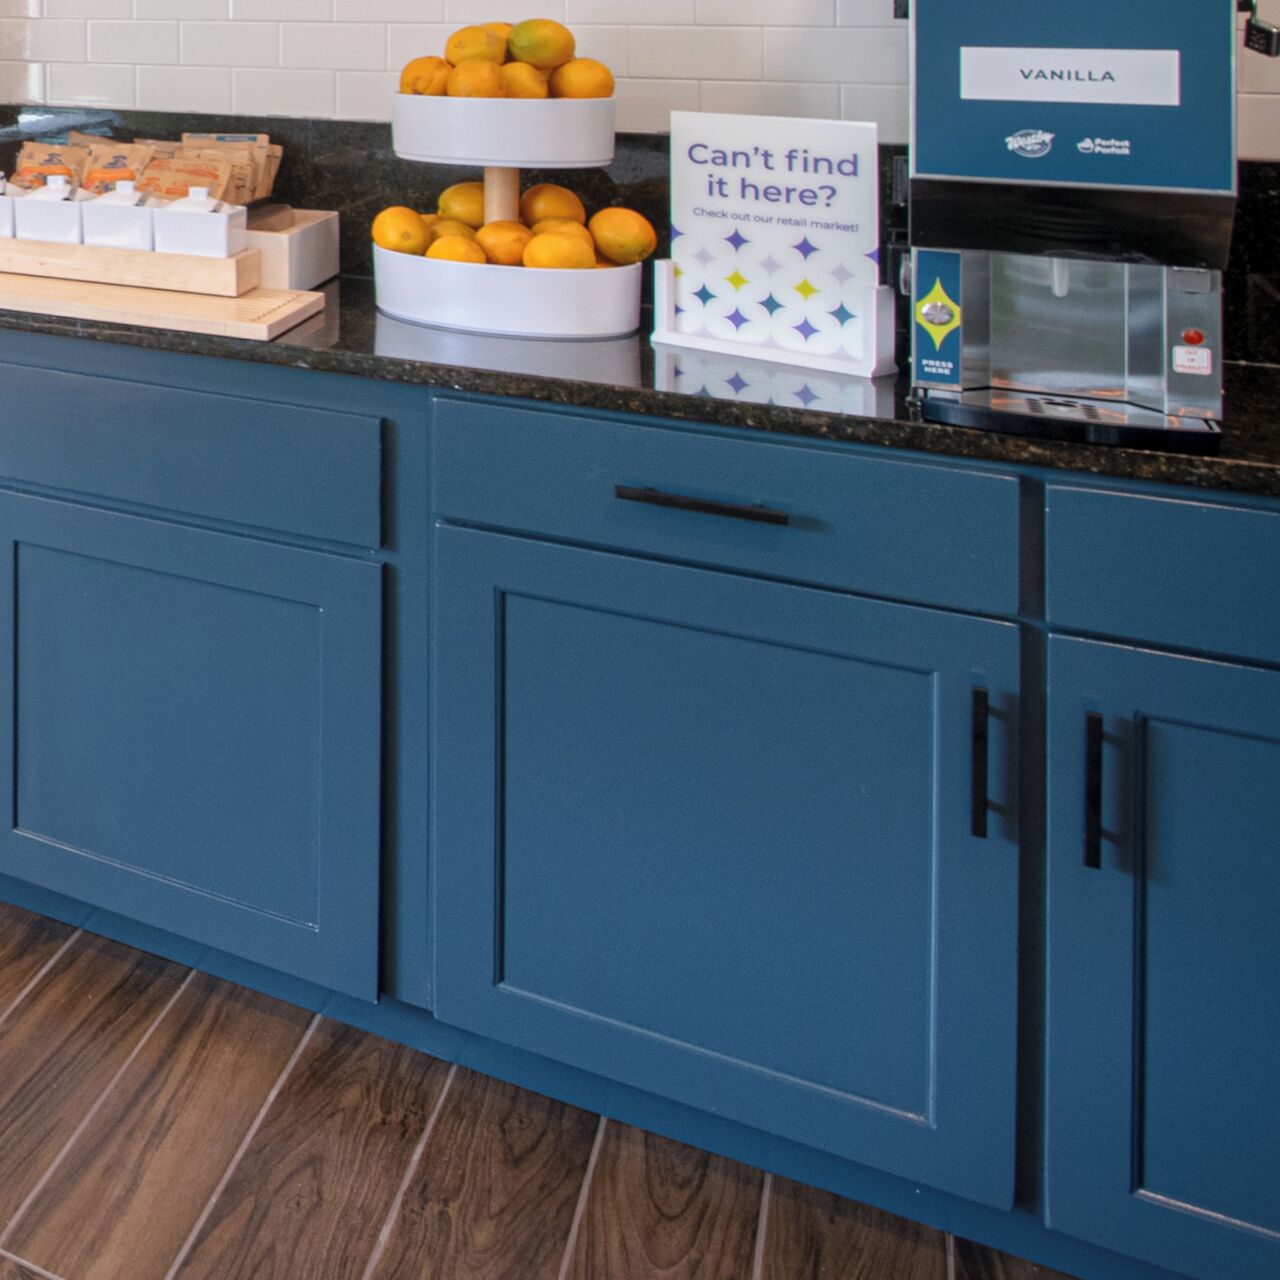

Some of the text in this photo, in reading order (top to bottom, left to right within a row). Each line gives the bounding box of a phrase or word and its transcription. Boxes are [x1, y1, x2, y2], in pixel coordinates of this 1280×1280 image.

[1019, 68, 1116, 82] VANILLA
[1094, 138, 1130, 148] Perfect
[687, 143, 859, 177] Can't find
[707, 173, 838, 208] it here?
[693, 206, 859, 233] Check out our retail market!
[922, 359, 954, 368] PRESS
[924, 366, 951, 375] HERE
